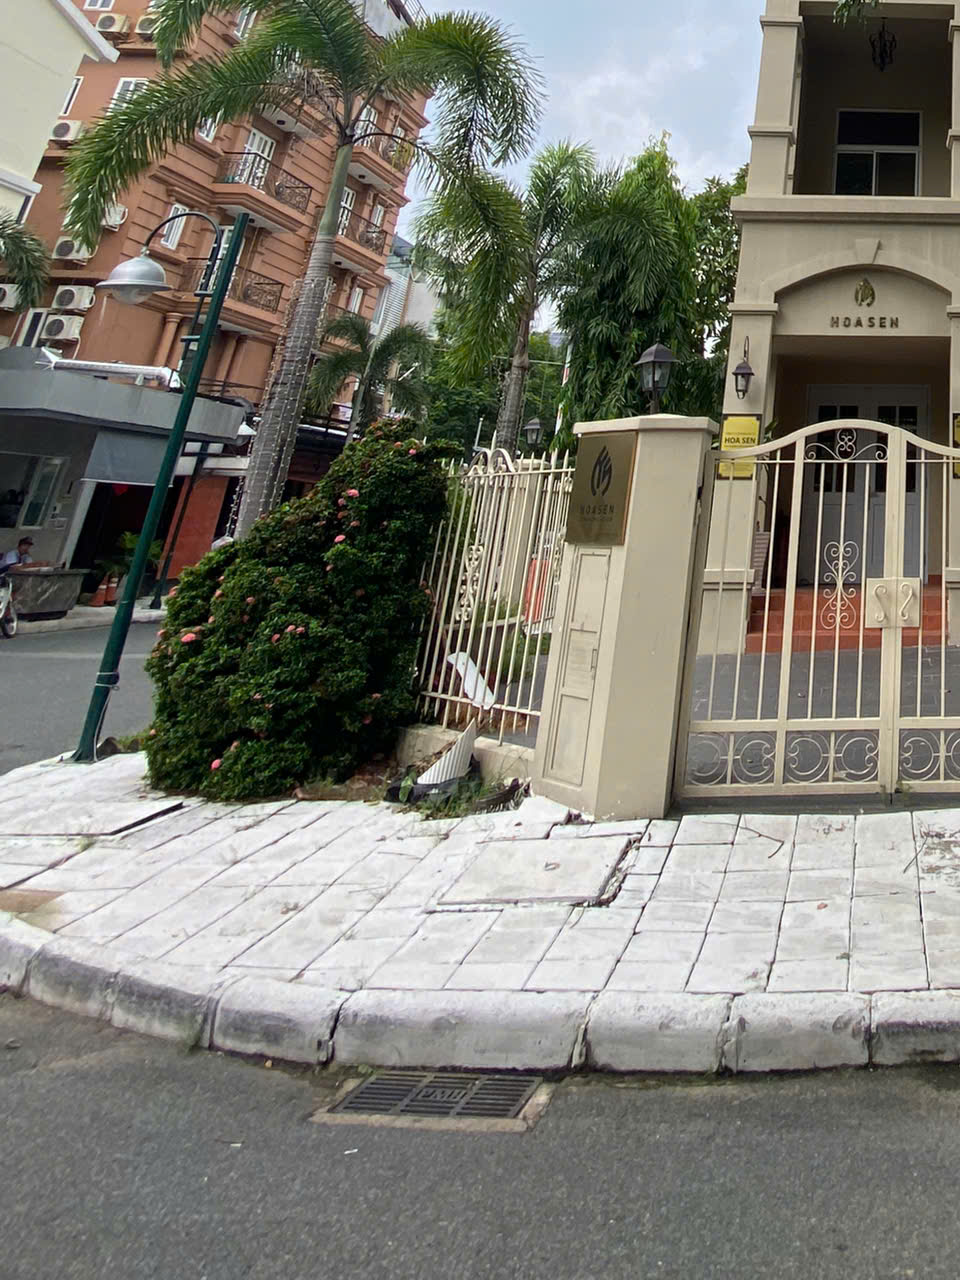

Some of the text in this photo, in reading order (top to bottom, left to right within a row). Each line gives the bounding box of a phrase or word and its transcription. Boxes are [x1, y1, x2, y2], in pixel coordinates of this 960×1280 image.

[830, 316, 899, 328] HOASEN
[724, 436, 756, 444] HOA SEN
